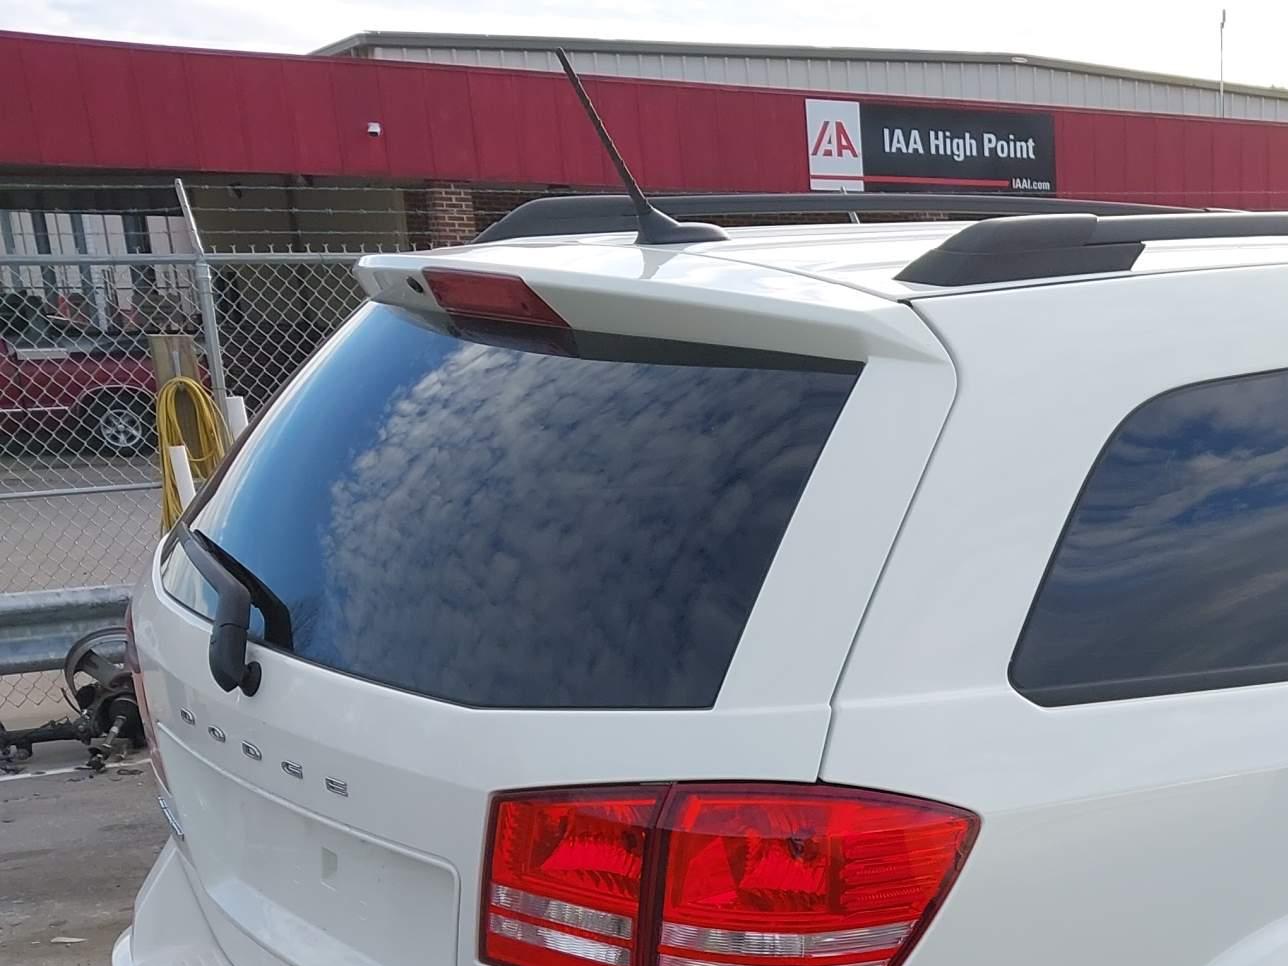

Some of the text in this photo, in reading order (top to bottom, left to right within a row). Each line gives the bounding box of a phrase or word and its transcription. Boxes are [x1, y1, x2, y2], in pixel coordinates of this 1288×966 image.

[883, 128, 1036, 161] IAA High Point
[1012, 178, 1051, 191] IAAI.com
[180, 707, 349, 798] DODGE
